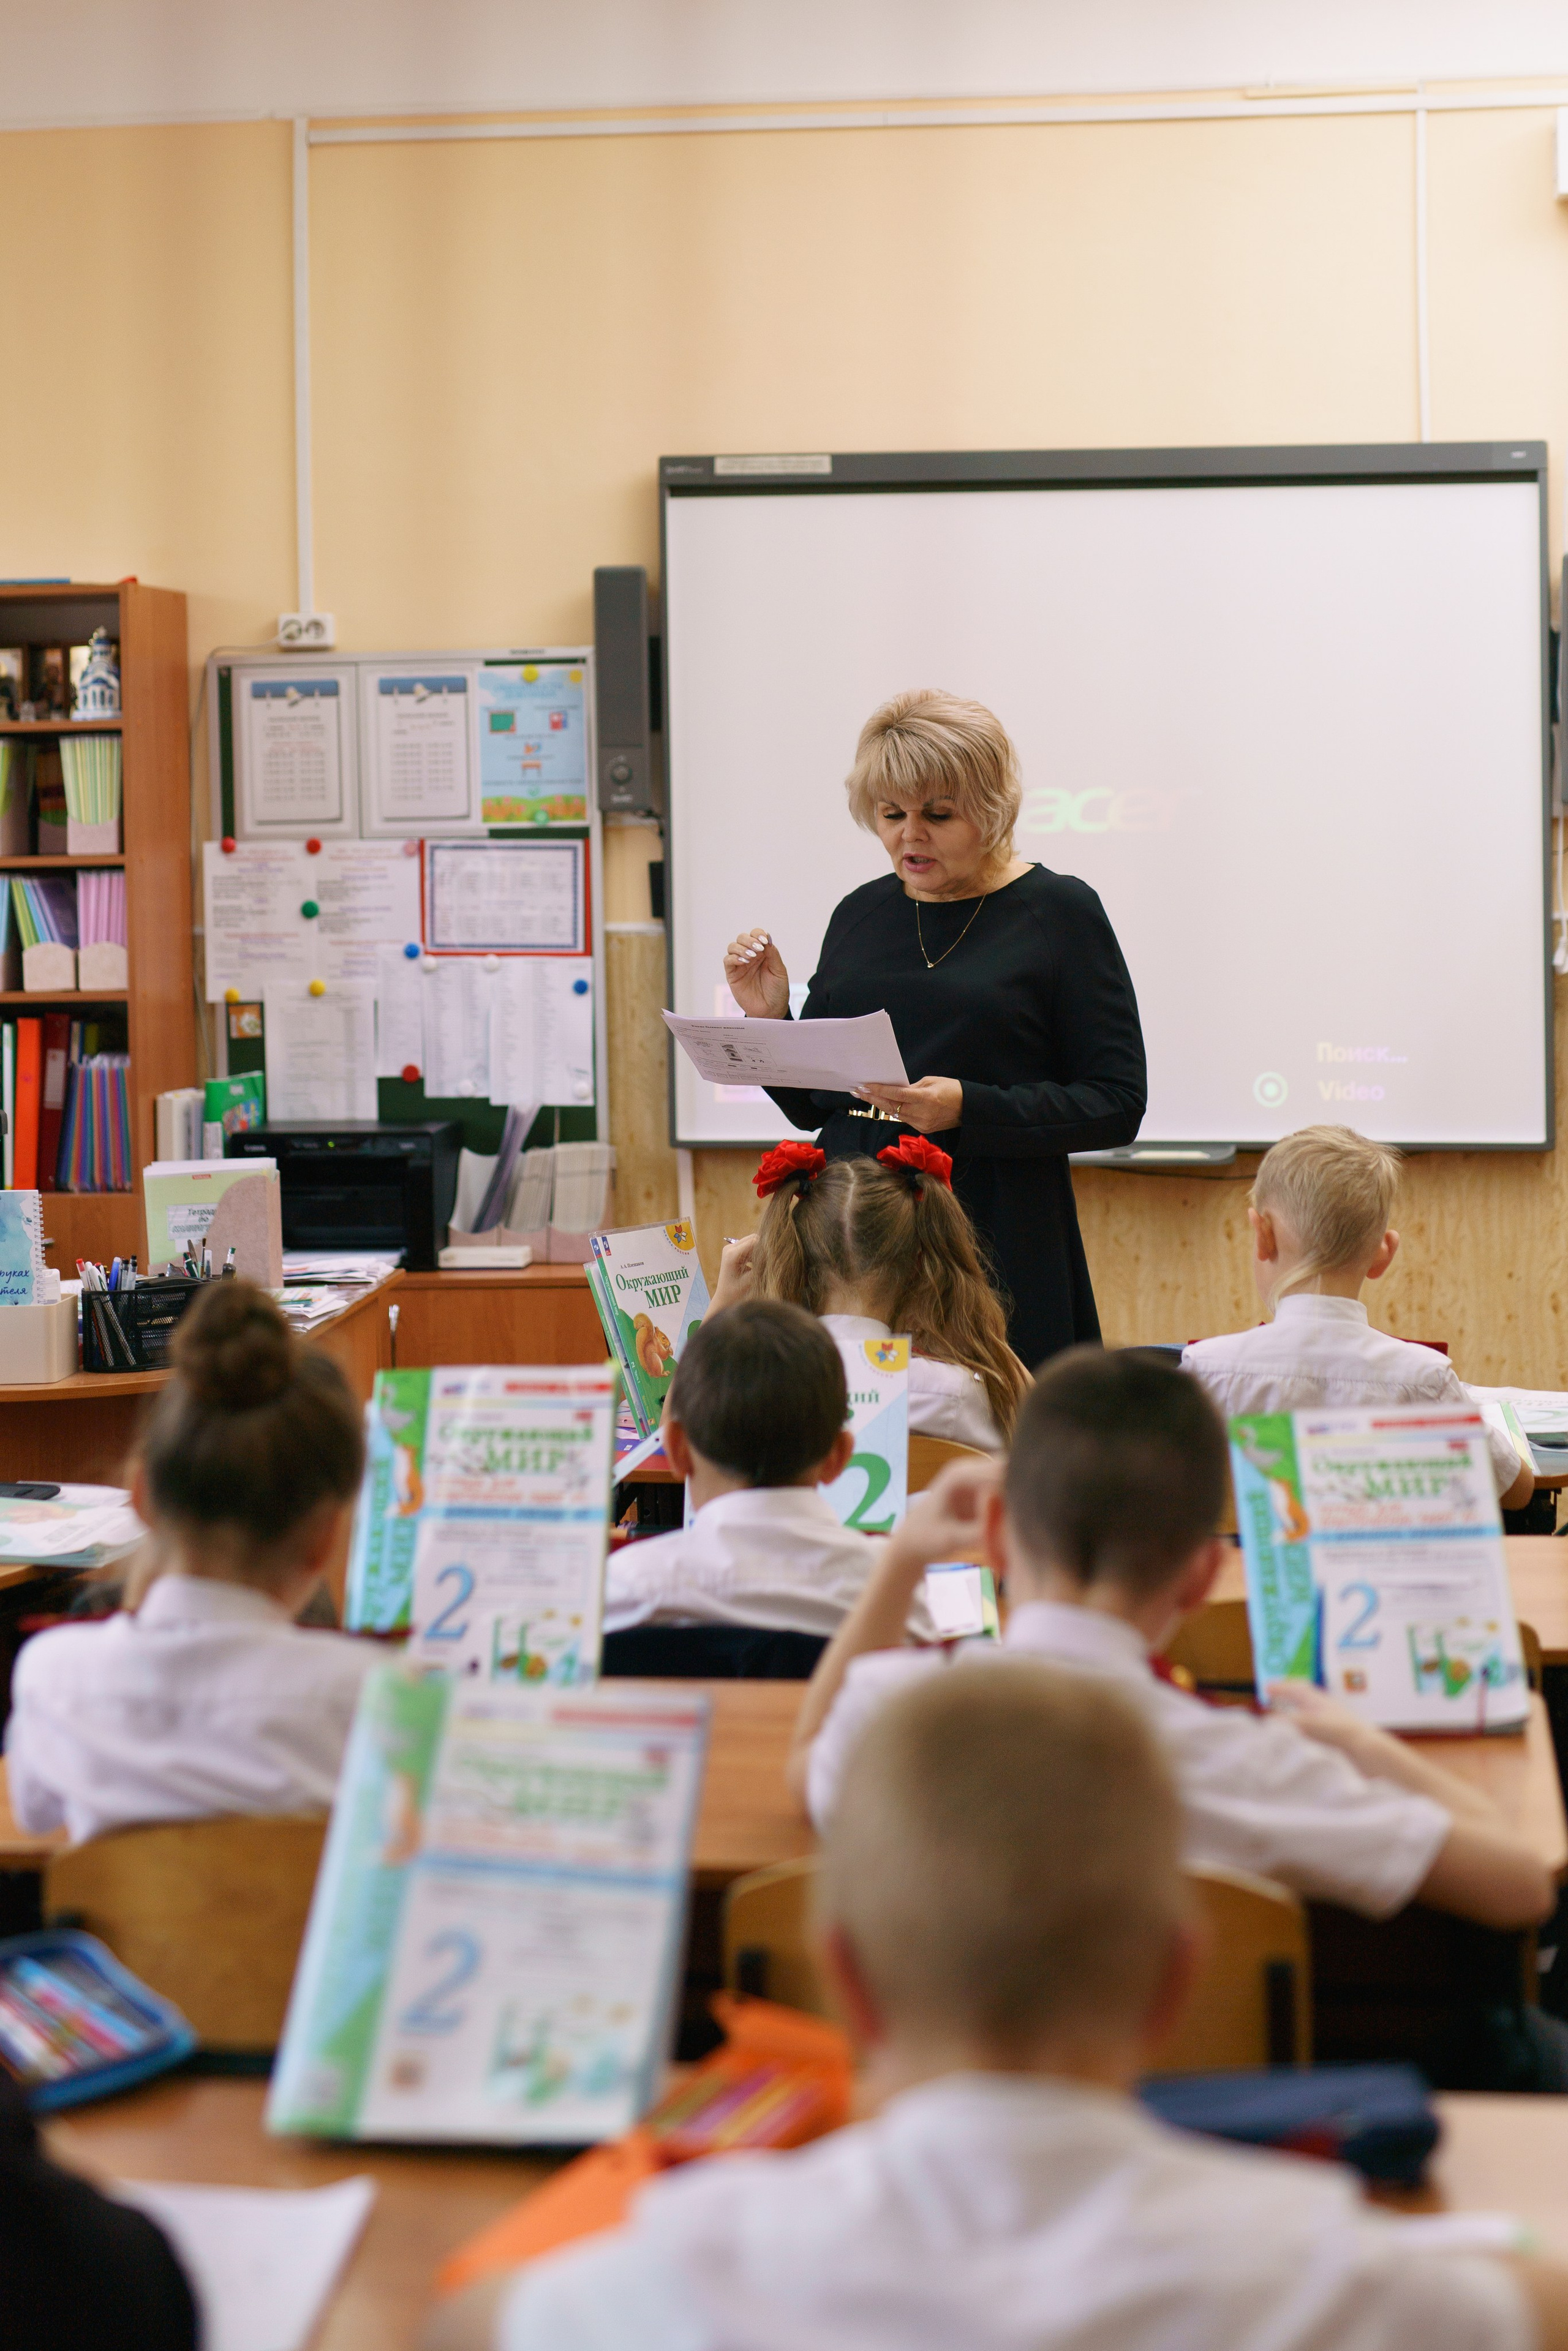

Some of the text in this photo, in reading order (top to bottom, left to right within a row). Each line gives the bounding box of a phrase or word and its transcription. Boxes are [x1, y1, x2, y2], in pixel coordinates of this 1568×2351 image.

[1018, 787, 1202, 834] acer
[1317, 1081, 1385, 1101] Video
[616, 1266, 690, 1292] Окружающий
[644, 1285, 681, 1308] МИР
[843, 1452, 896, 1533] 2
[424, 1564, 474, 1640] 2
[1336, 1580, 1382, 1650] 2
[396, 1924, 483, 2037] 2
